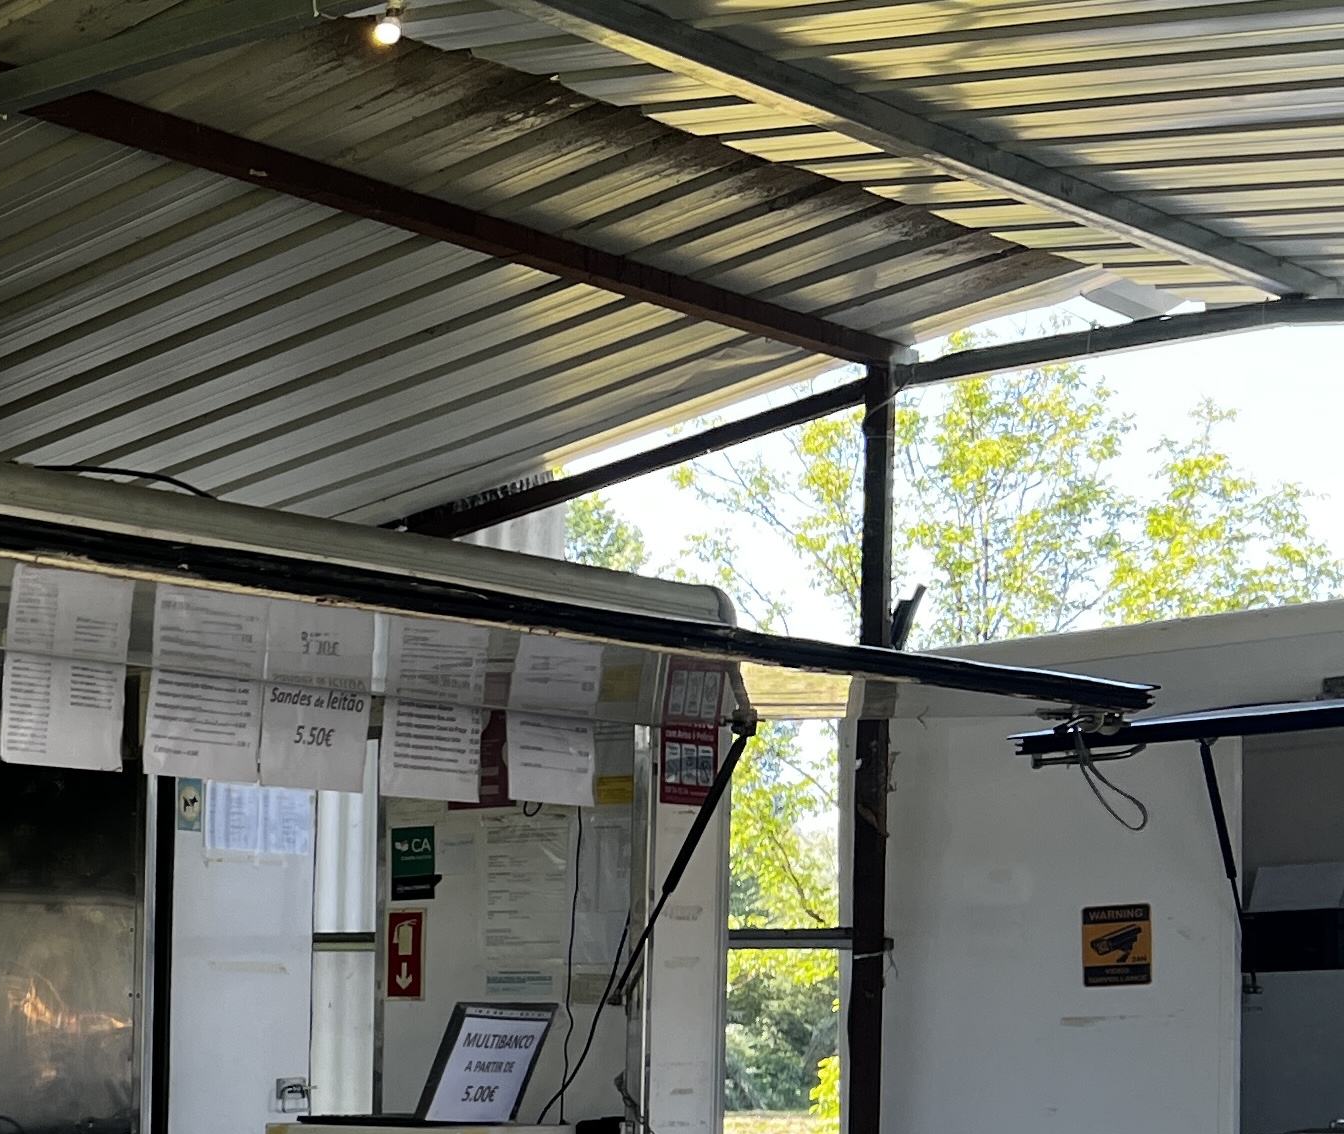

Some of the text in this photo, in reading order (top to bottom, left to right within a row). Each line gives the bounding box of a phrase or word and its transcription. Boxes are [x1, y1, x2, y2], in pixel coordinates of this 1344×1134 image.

[270, 688, 364, 713] Sandes de leitão
[294, 726, 336, 748] 5.50€
[411, 838, 432, 853] CA
[1088, 908, 1144, 921] WARNING
[462, 1032, 534, 1050] MULTIBANCO
[464, 1060, 516, 1073] A PARTIR DE
[461, 1085, 499, 1103] 5.00€
